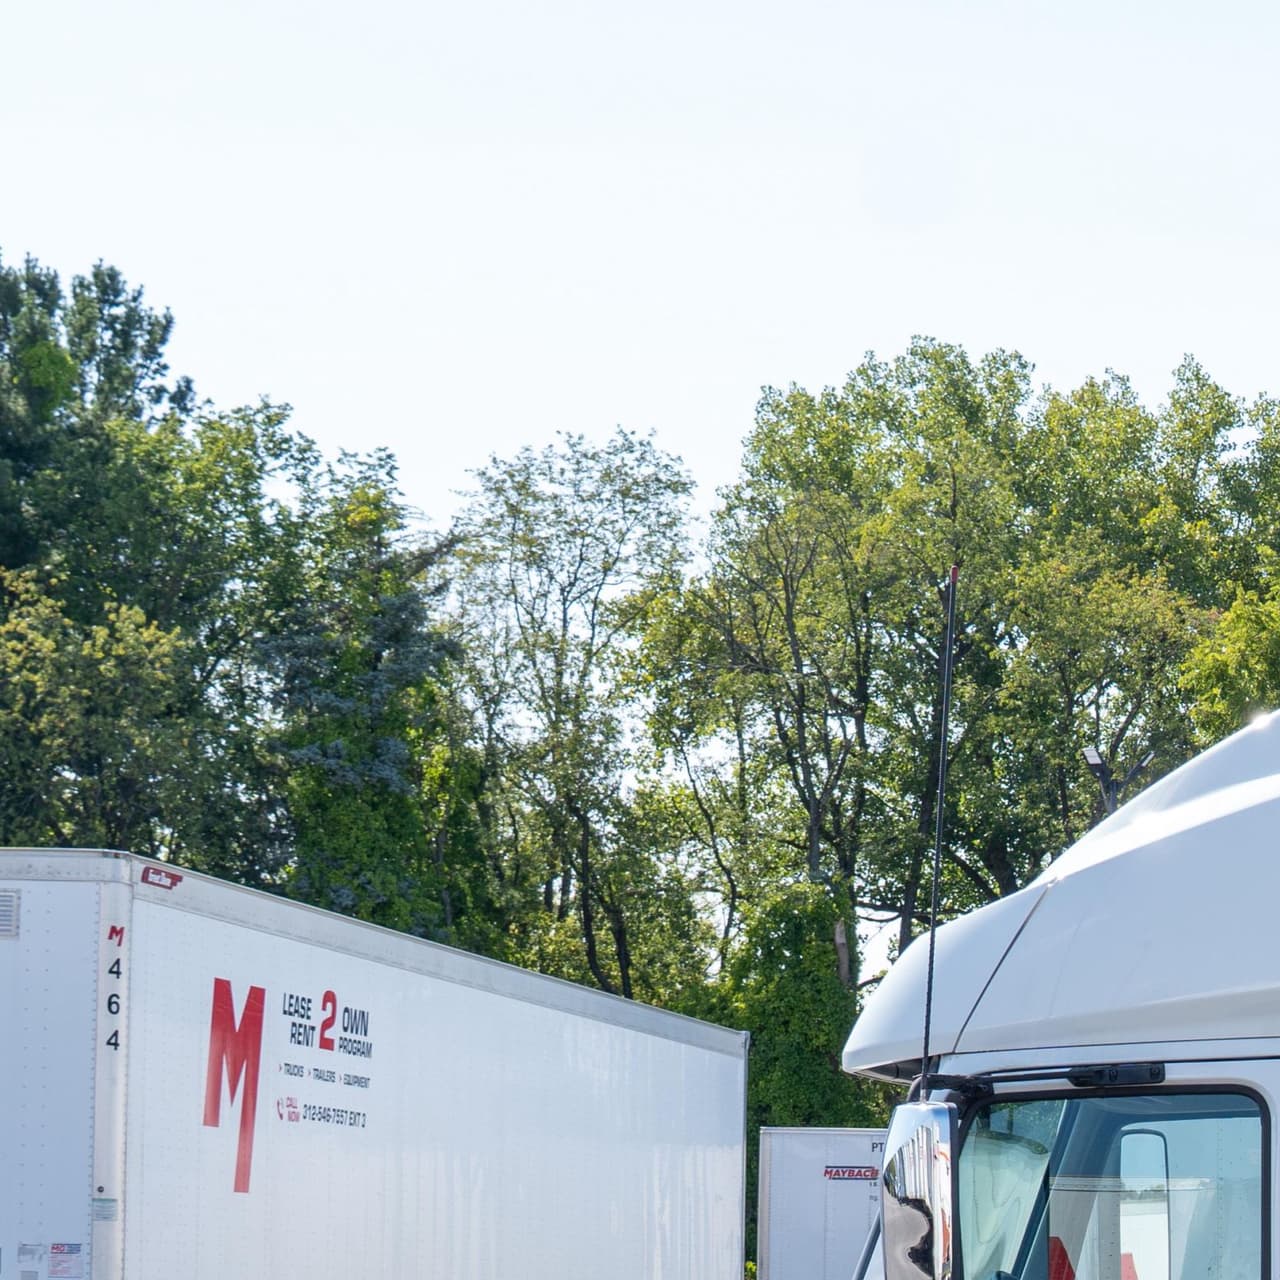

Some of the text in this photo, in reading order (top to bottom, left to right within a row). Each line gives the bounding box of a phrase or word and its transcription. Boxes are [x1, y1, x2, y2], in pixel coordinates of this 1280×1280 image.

[282, 989, 370, 1052] LEASE 2 OWN
[290, 1022, 373, 1059] RENT PROGRAM
[824, 1166, 879, 1180] MAYBACH
